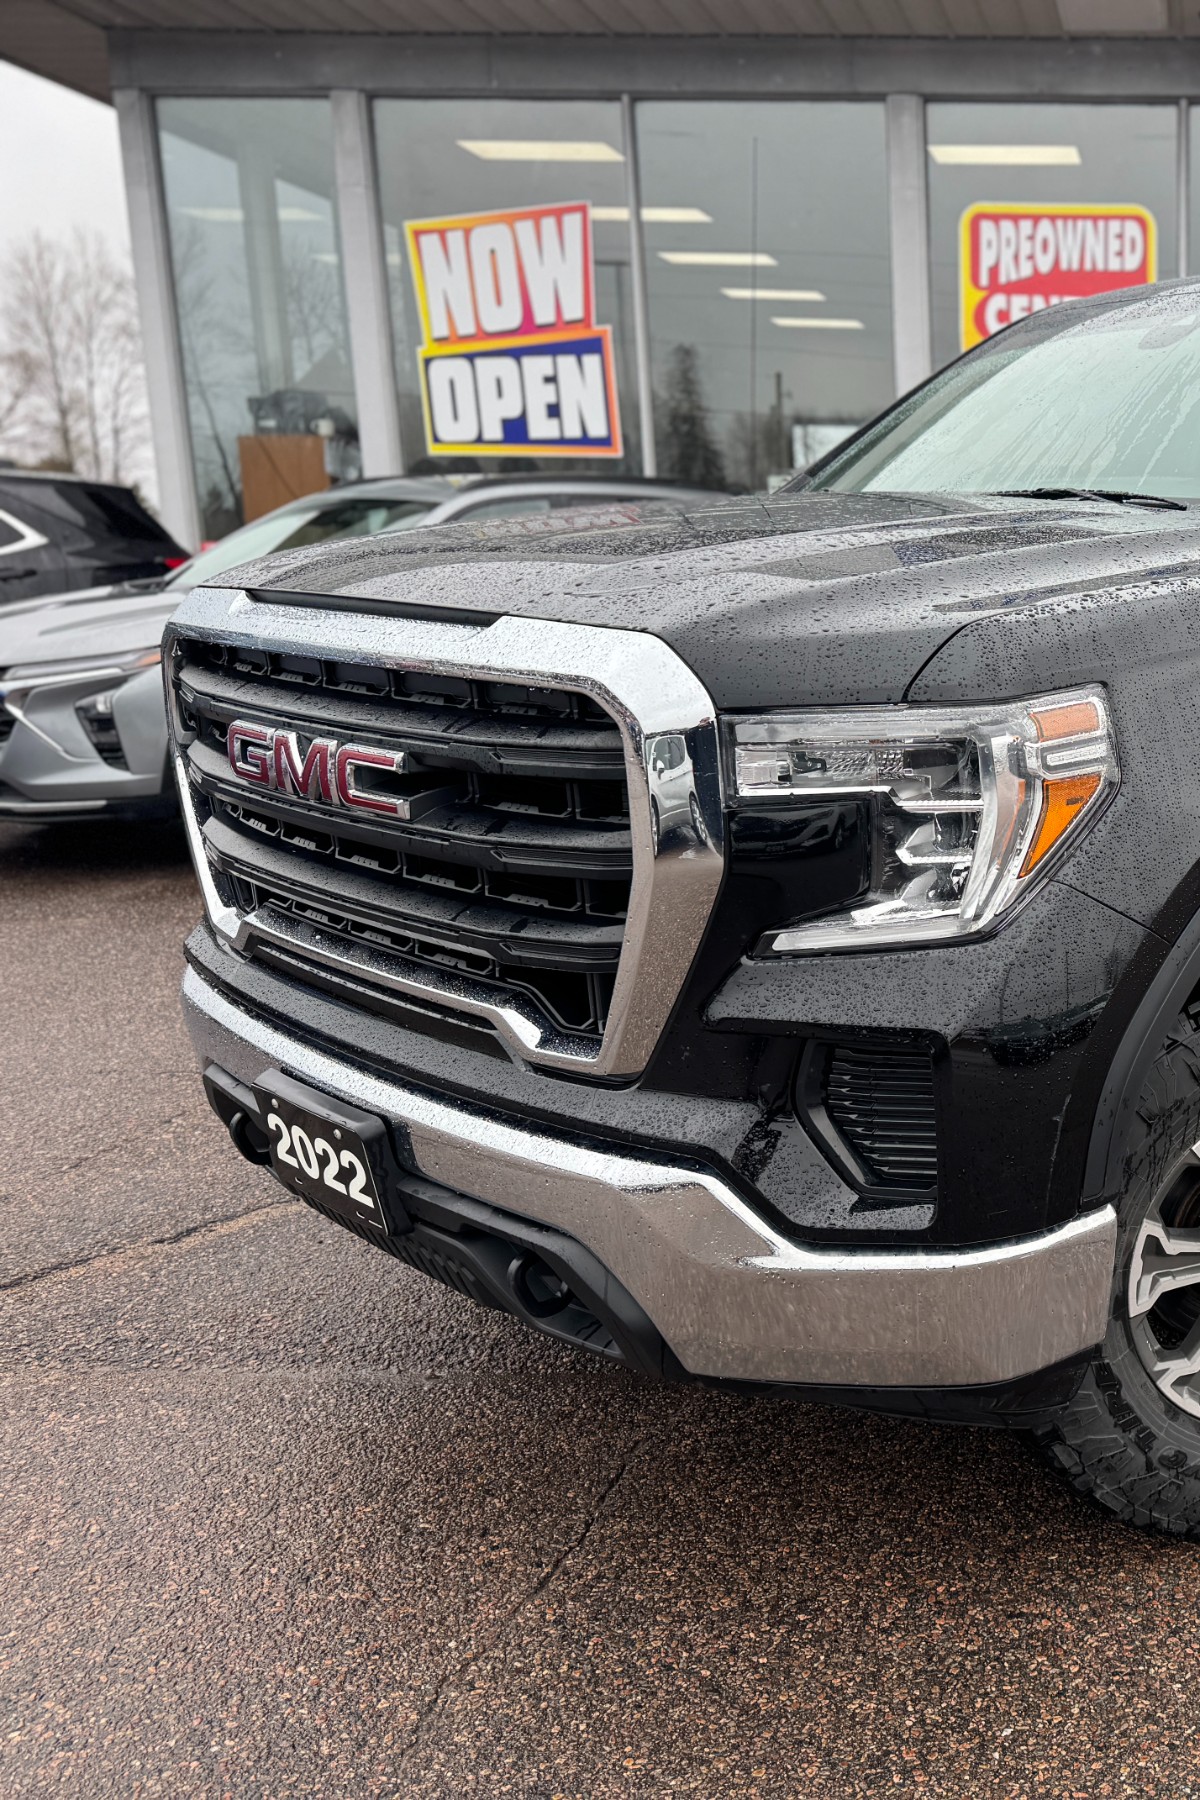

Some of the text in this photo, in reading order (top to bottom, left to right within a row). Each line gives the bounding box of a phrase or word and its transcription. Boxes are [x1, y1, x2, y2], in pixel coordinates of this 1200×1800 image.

[418, 211, 585, 342] NOW
[978, 216, 1146, 289] PREOWNED
[427, 352, 611, 444] OPEN
[227, 718, 411, 821] GMC
[267, 1112, 376, 1210] 2022
